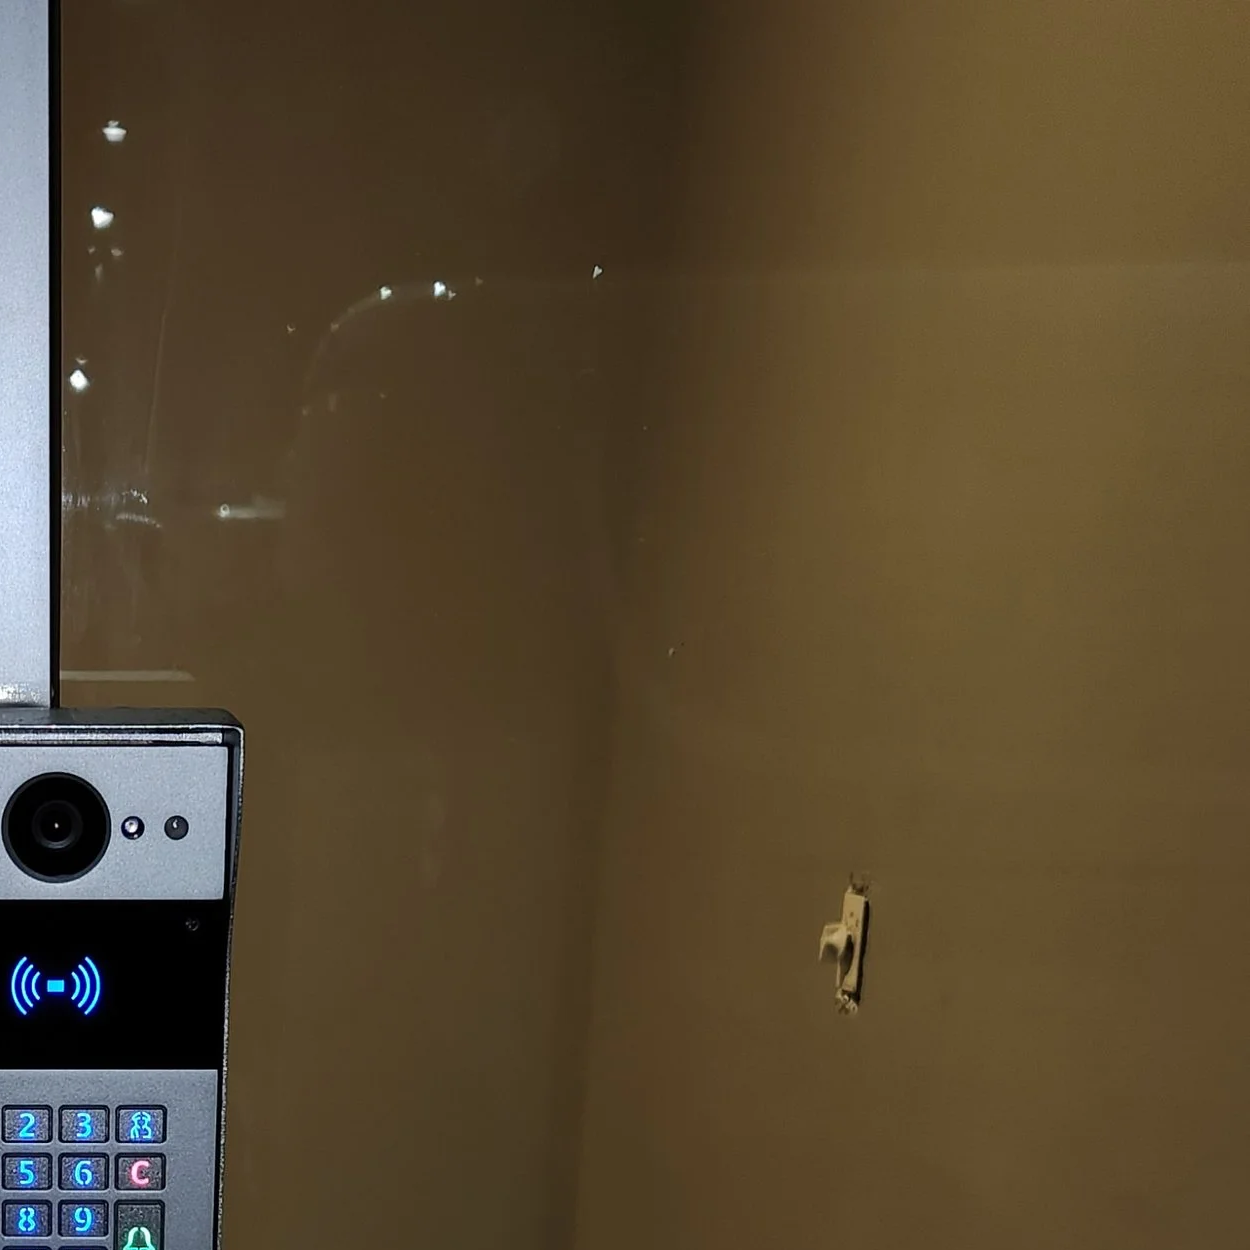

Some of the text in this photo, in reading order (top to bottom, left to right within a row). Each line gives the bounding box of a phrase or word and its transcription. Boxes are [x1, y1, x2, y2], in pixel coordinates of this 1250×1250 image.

[18, 1112, 36, 1138] 2
[75, 1112, 93, 1139] 3
[18, 1160, 36, 1185] 5
[73, 1159, 94, 1186] 6
[130, 1159, 150, 1185] C
[17, 1206, 37, 1232] 8
[73, 1206, 93, 1232] 9
